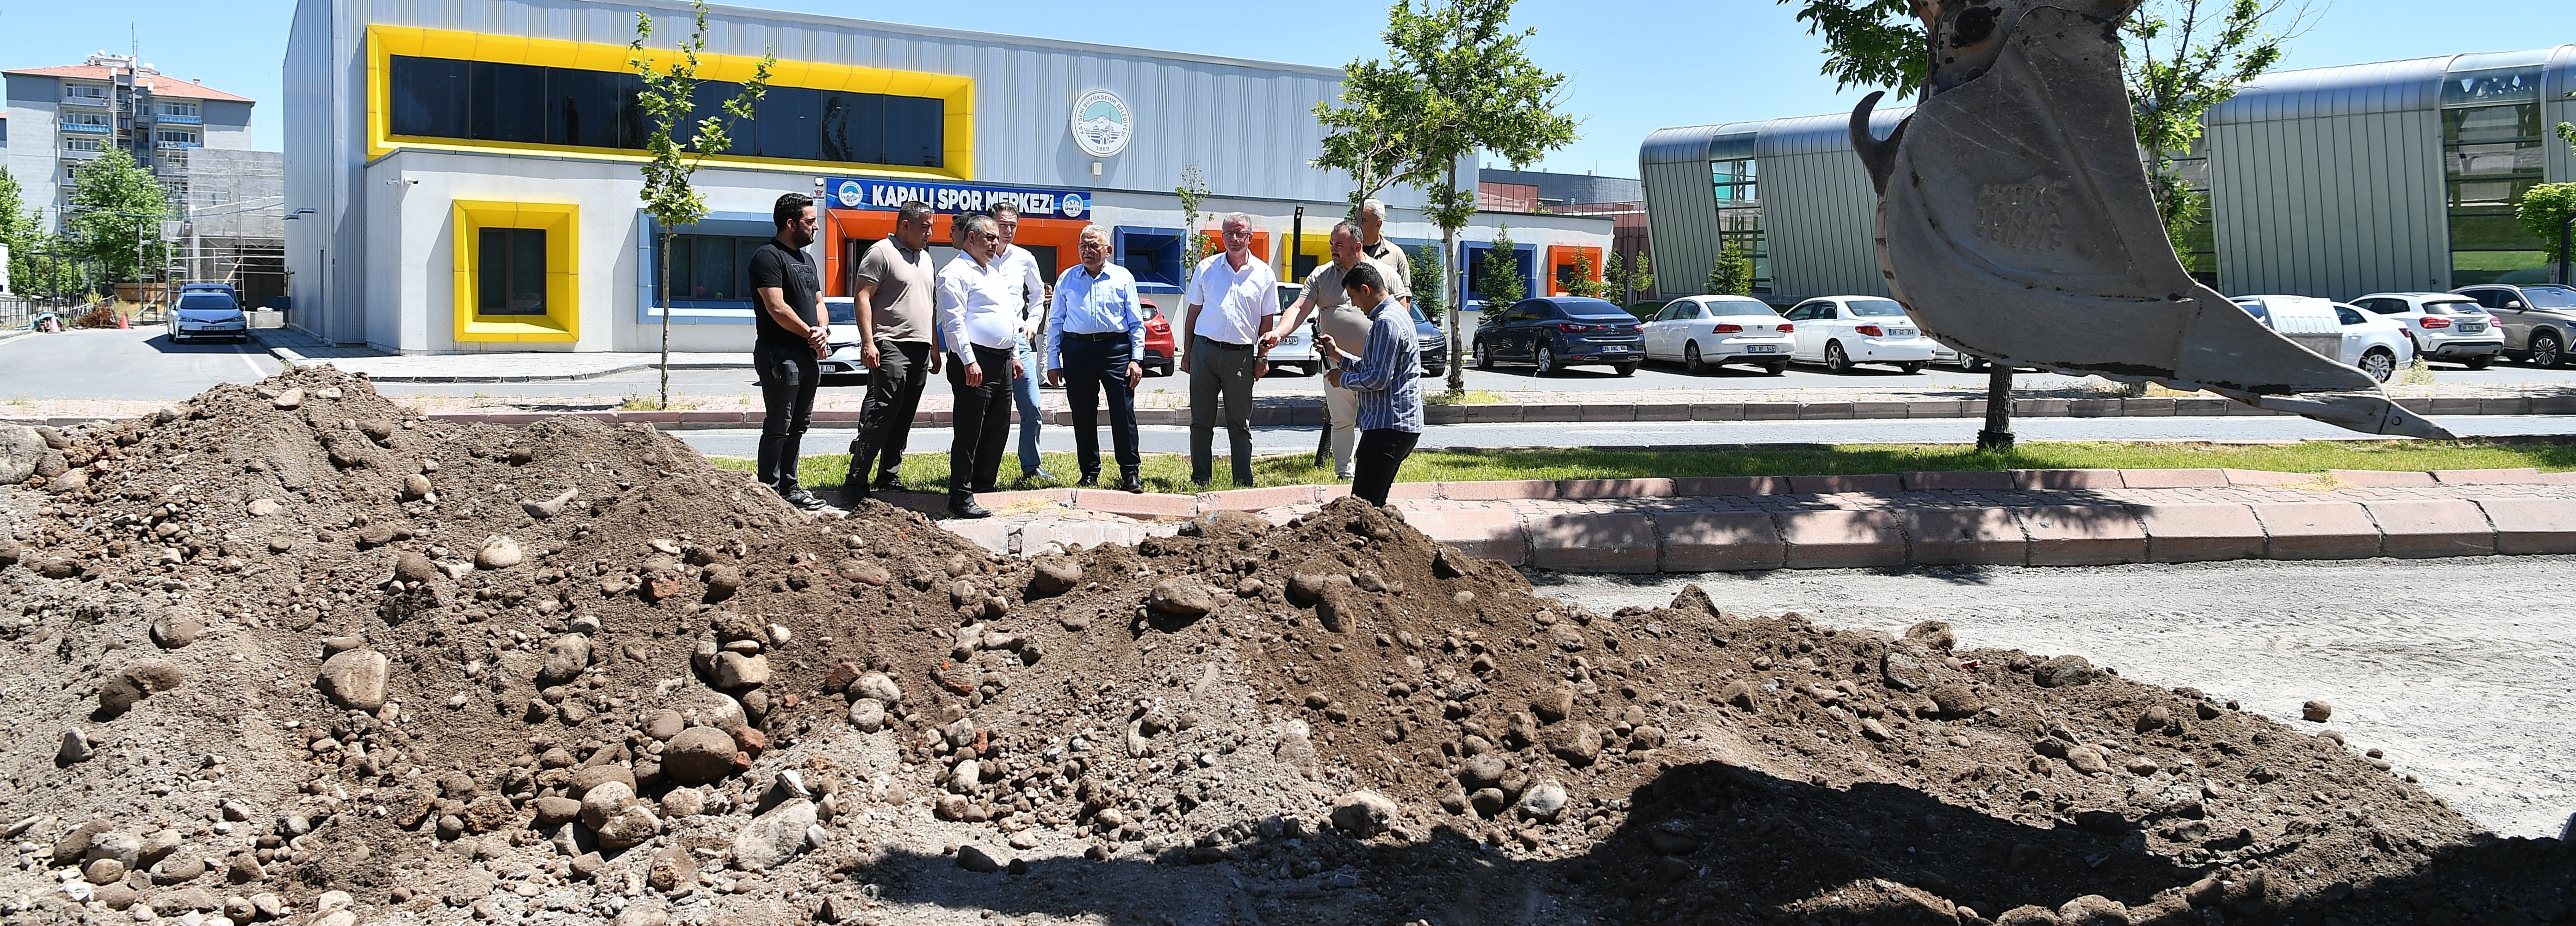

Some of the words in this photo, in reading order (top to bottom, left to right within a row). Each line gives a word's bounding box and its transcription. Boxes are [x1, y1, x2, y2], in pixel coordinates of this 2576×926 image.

[1084, 95, 1116, 108] BÜYÜKŞEHİR
[873, 185, 934, 209] KAPALI
[937, 188, 982, 211] SPOR
[985, 191, 1054, 214] MERKEZİ
